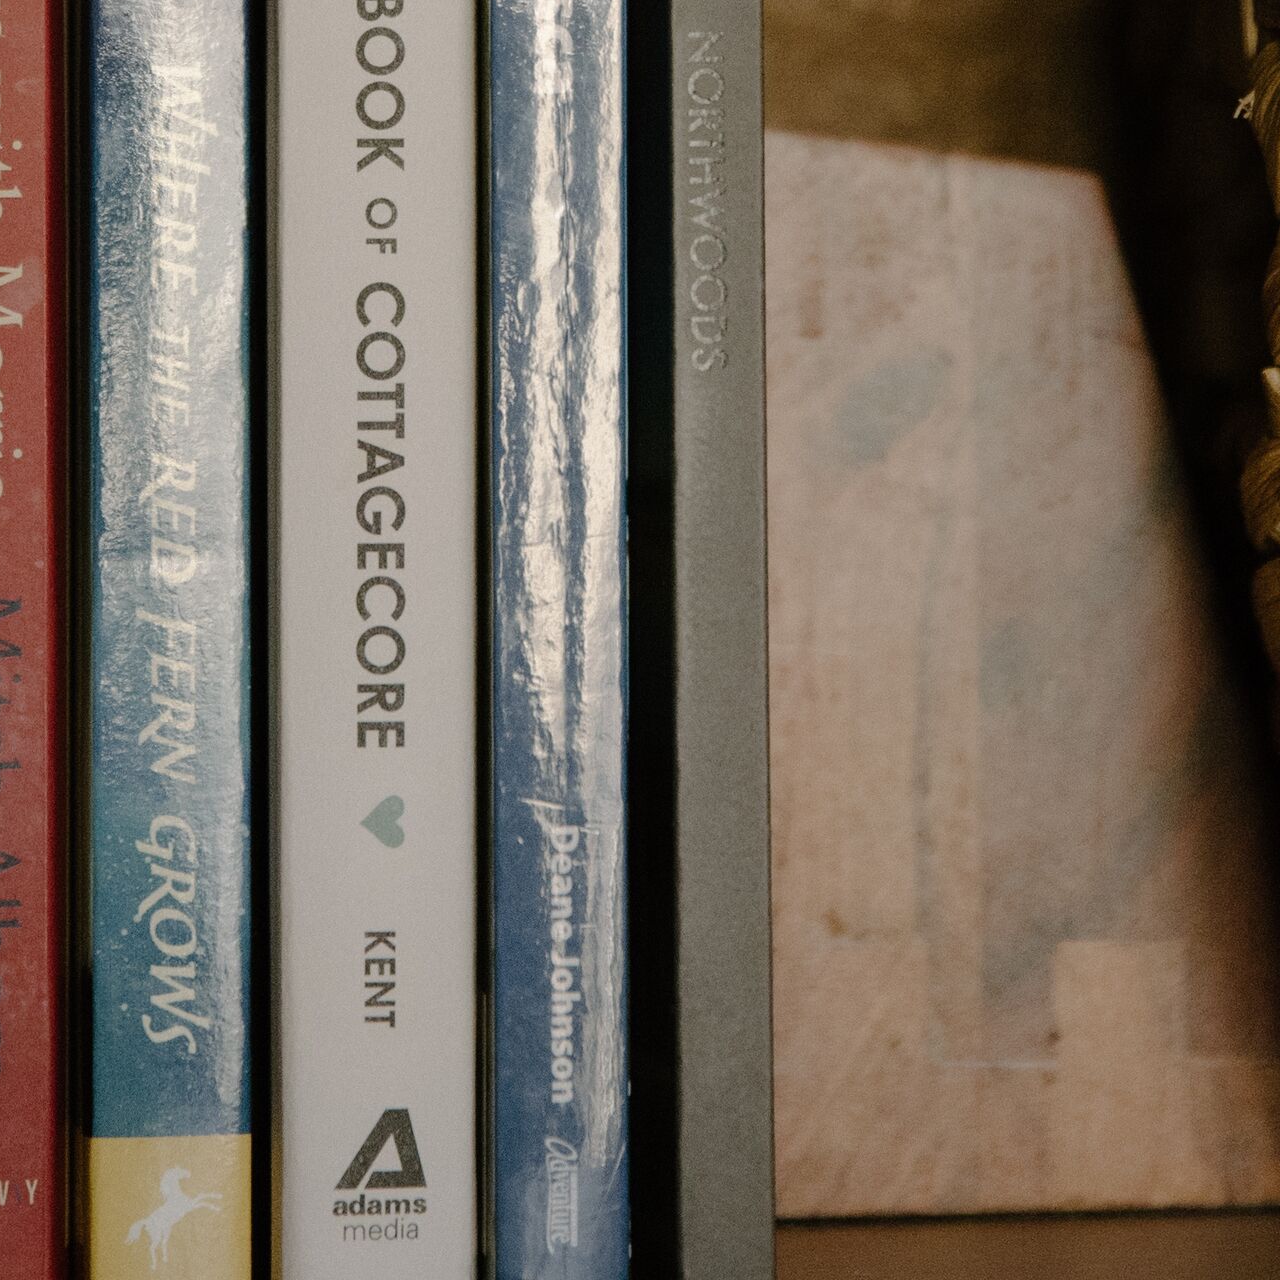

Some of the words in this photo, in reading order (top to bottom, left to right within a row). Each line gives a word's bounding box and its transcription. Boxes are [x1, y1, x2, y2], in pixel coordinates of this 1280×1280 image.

[150, 61, 218, 297] WHERE
[364, 197, 398, 254] OF
[686, 30, 728, 372] NORTHWOODS
[150, 325, 191, 426] THE
[137, 452, 197, 584] RED
[353, 282, 405, 747] COTTAGECORE
[135, 609, 197, 784] FERN
[133, 815, 211, 1055] GROWS
[549, 826, 579, 941] Deane
[362, 931, 396, 1028] KENT
[549, 951, 579, 1104] Johnson
[332, 1193, 428, 1217] adams
[343, 1218, 420, 1243] media
